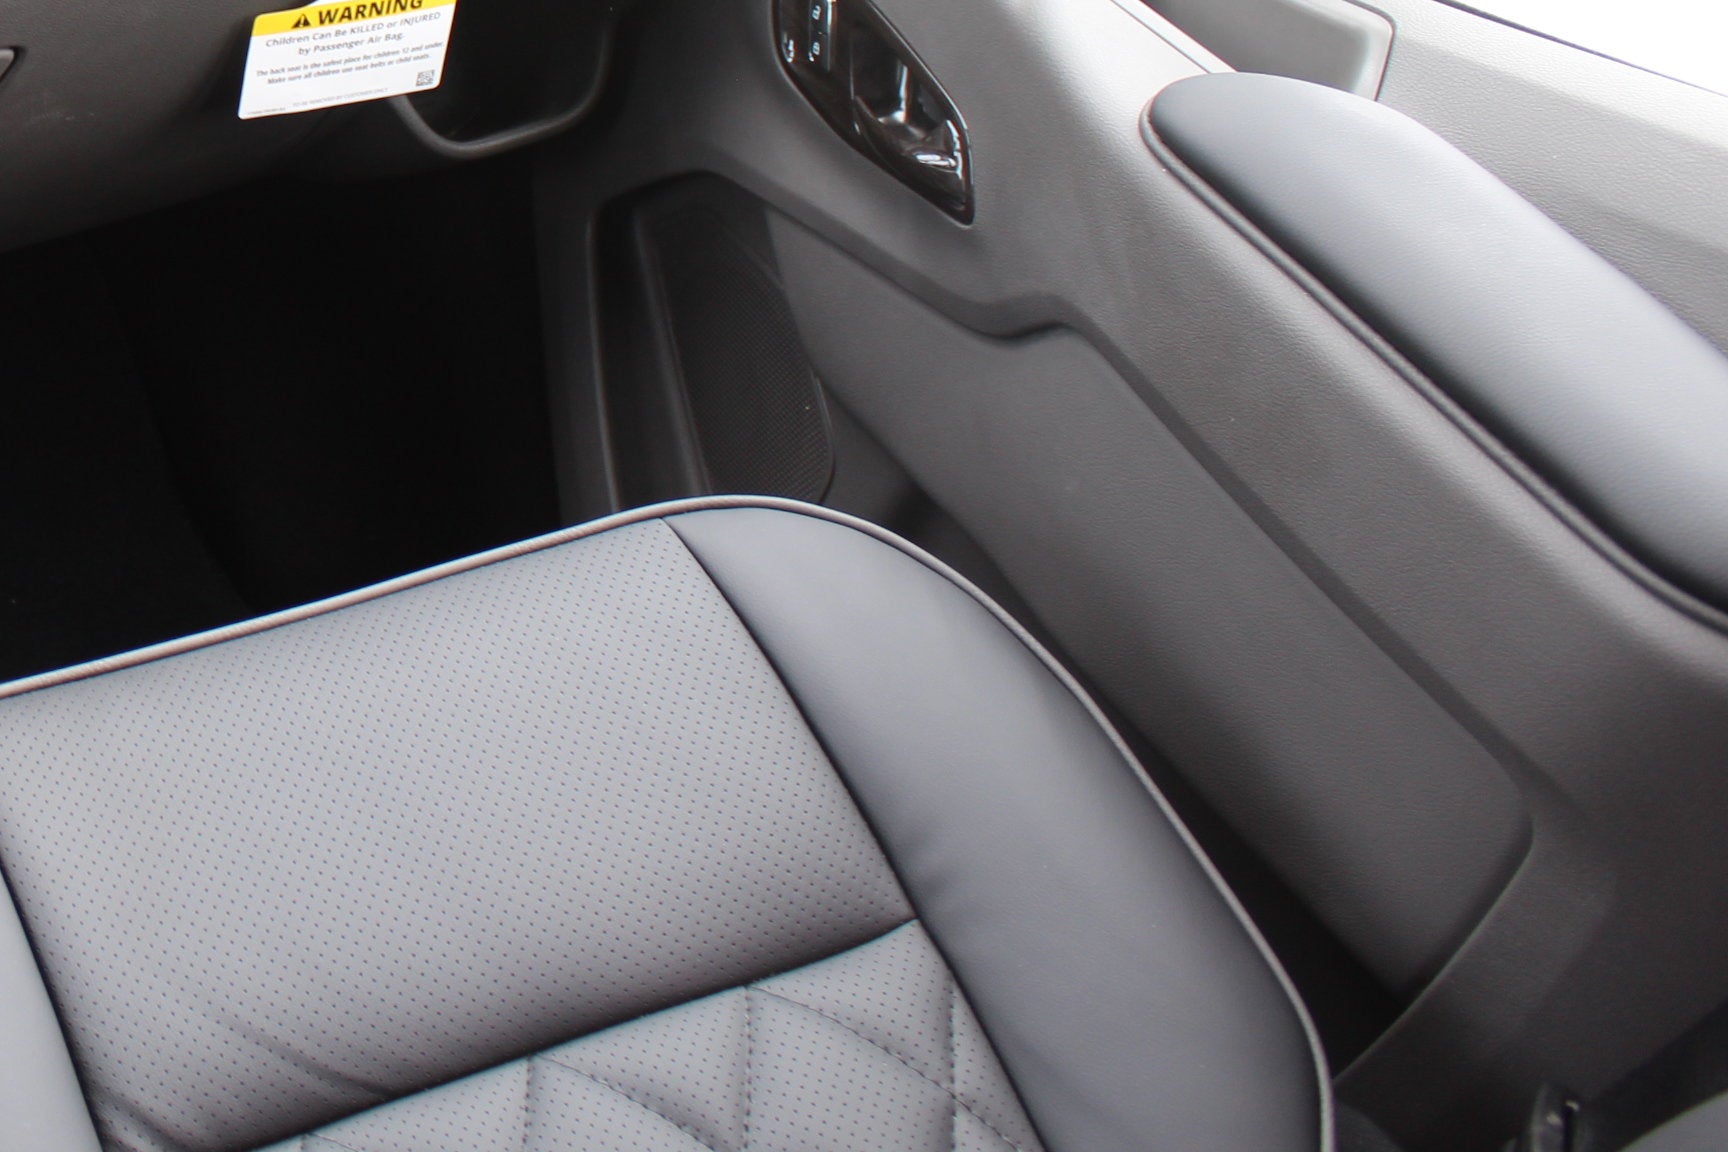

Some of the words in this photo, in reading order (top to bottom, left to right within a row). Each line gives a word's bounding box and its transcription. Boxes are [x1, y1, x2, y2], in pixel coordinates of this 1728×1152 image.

[265, 34, 310, 47] Children
[312, 31, 332, 41] Can
[335, 28, 348, 38] Be
[350, 22, 384, 35] KILLED
[386, 21, 398, 30] or
[400, 11, 441, 27] INJURED
[298, 45, 311, 56] by
[313, 39, 364, 53] Passenger
[367, 34, 382, 44] Air
